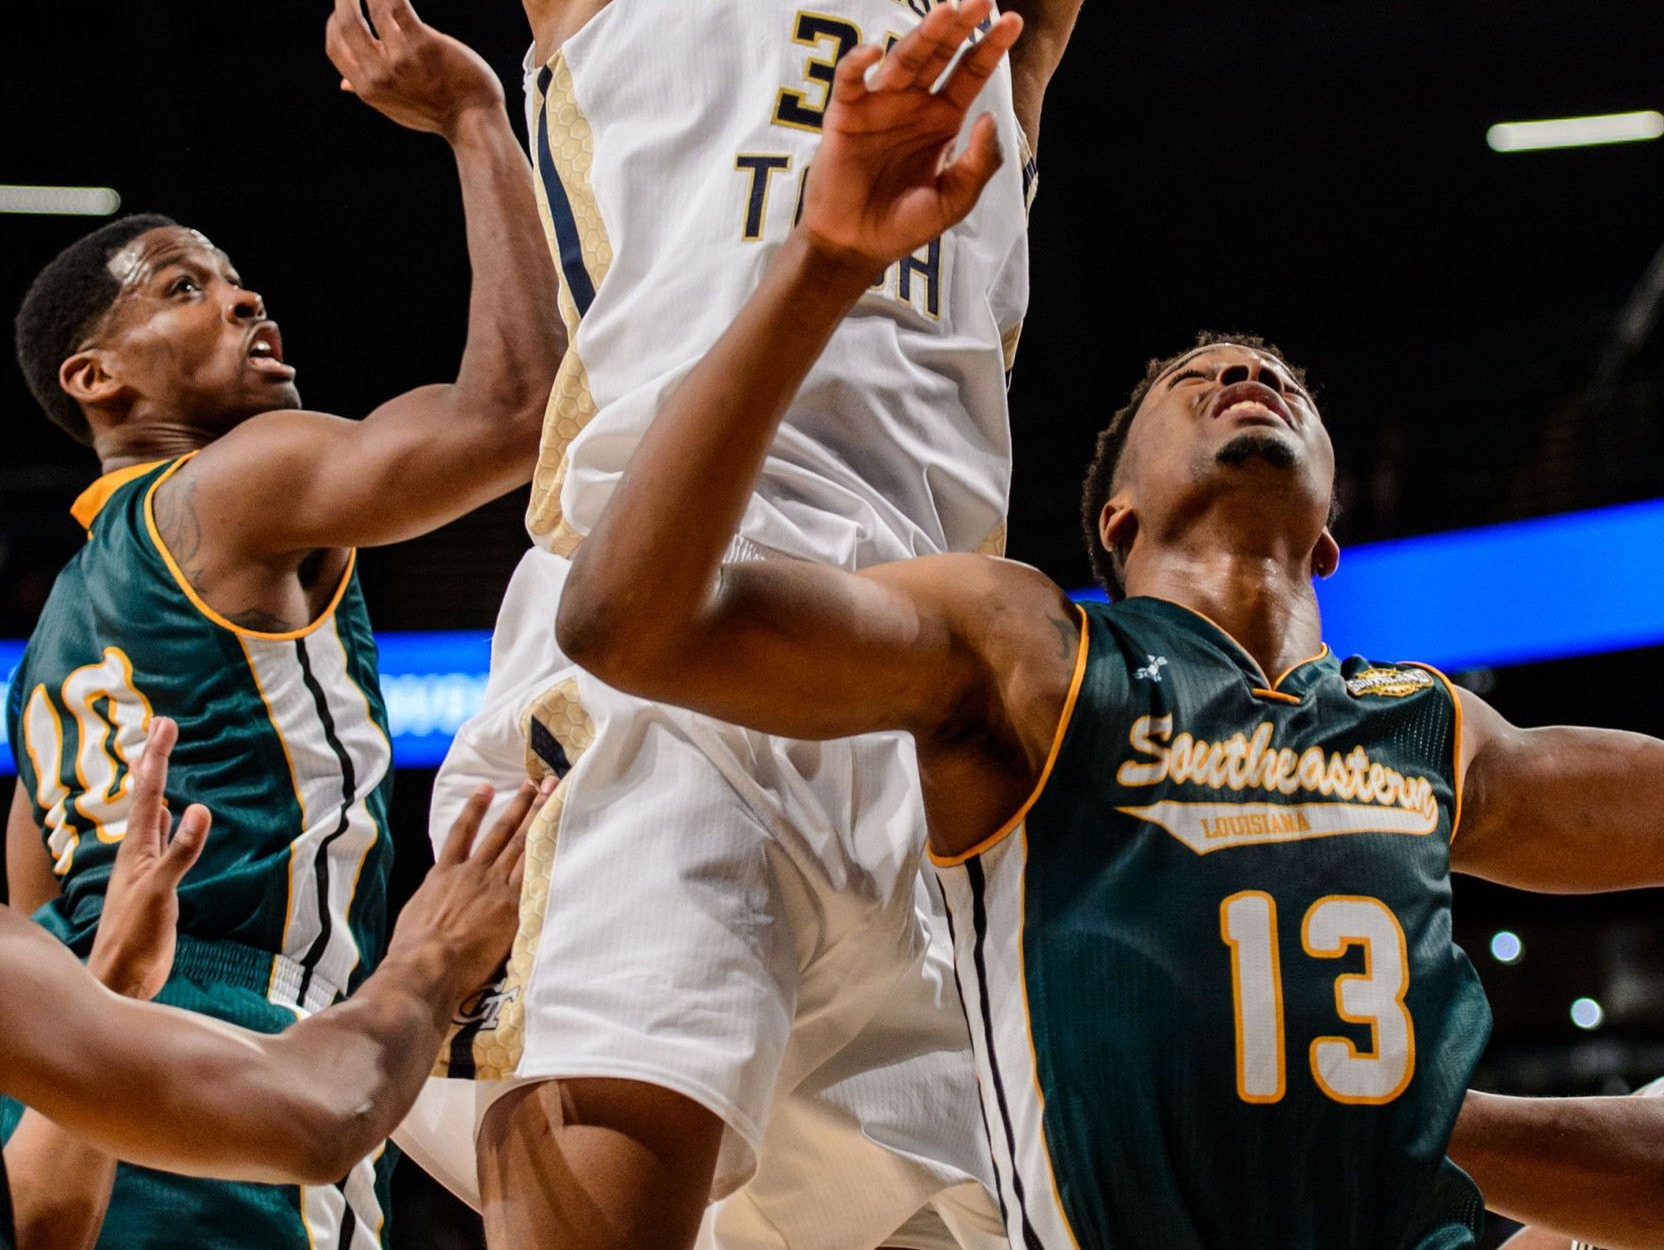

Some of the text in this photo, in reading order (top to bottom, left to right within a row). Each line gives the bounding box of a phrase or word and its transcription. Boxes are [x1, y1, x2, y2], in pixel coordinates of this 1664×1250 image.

[771, 10, 935, 133] 3
[735, 154, 943, 321] TH
[24, 647, 168, 875] 10
[1117, 715, 1439, 816] Southeastern
[1201, 811, 1312, 839] LOUISIANA
[1220, 891, 1415, 1105] 13
